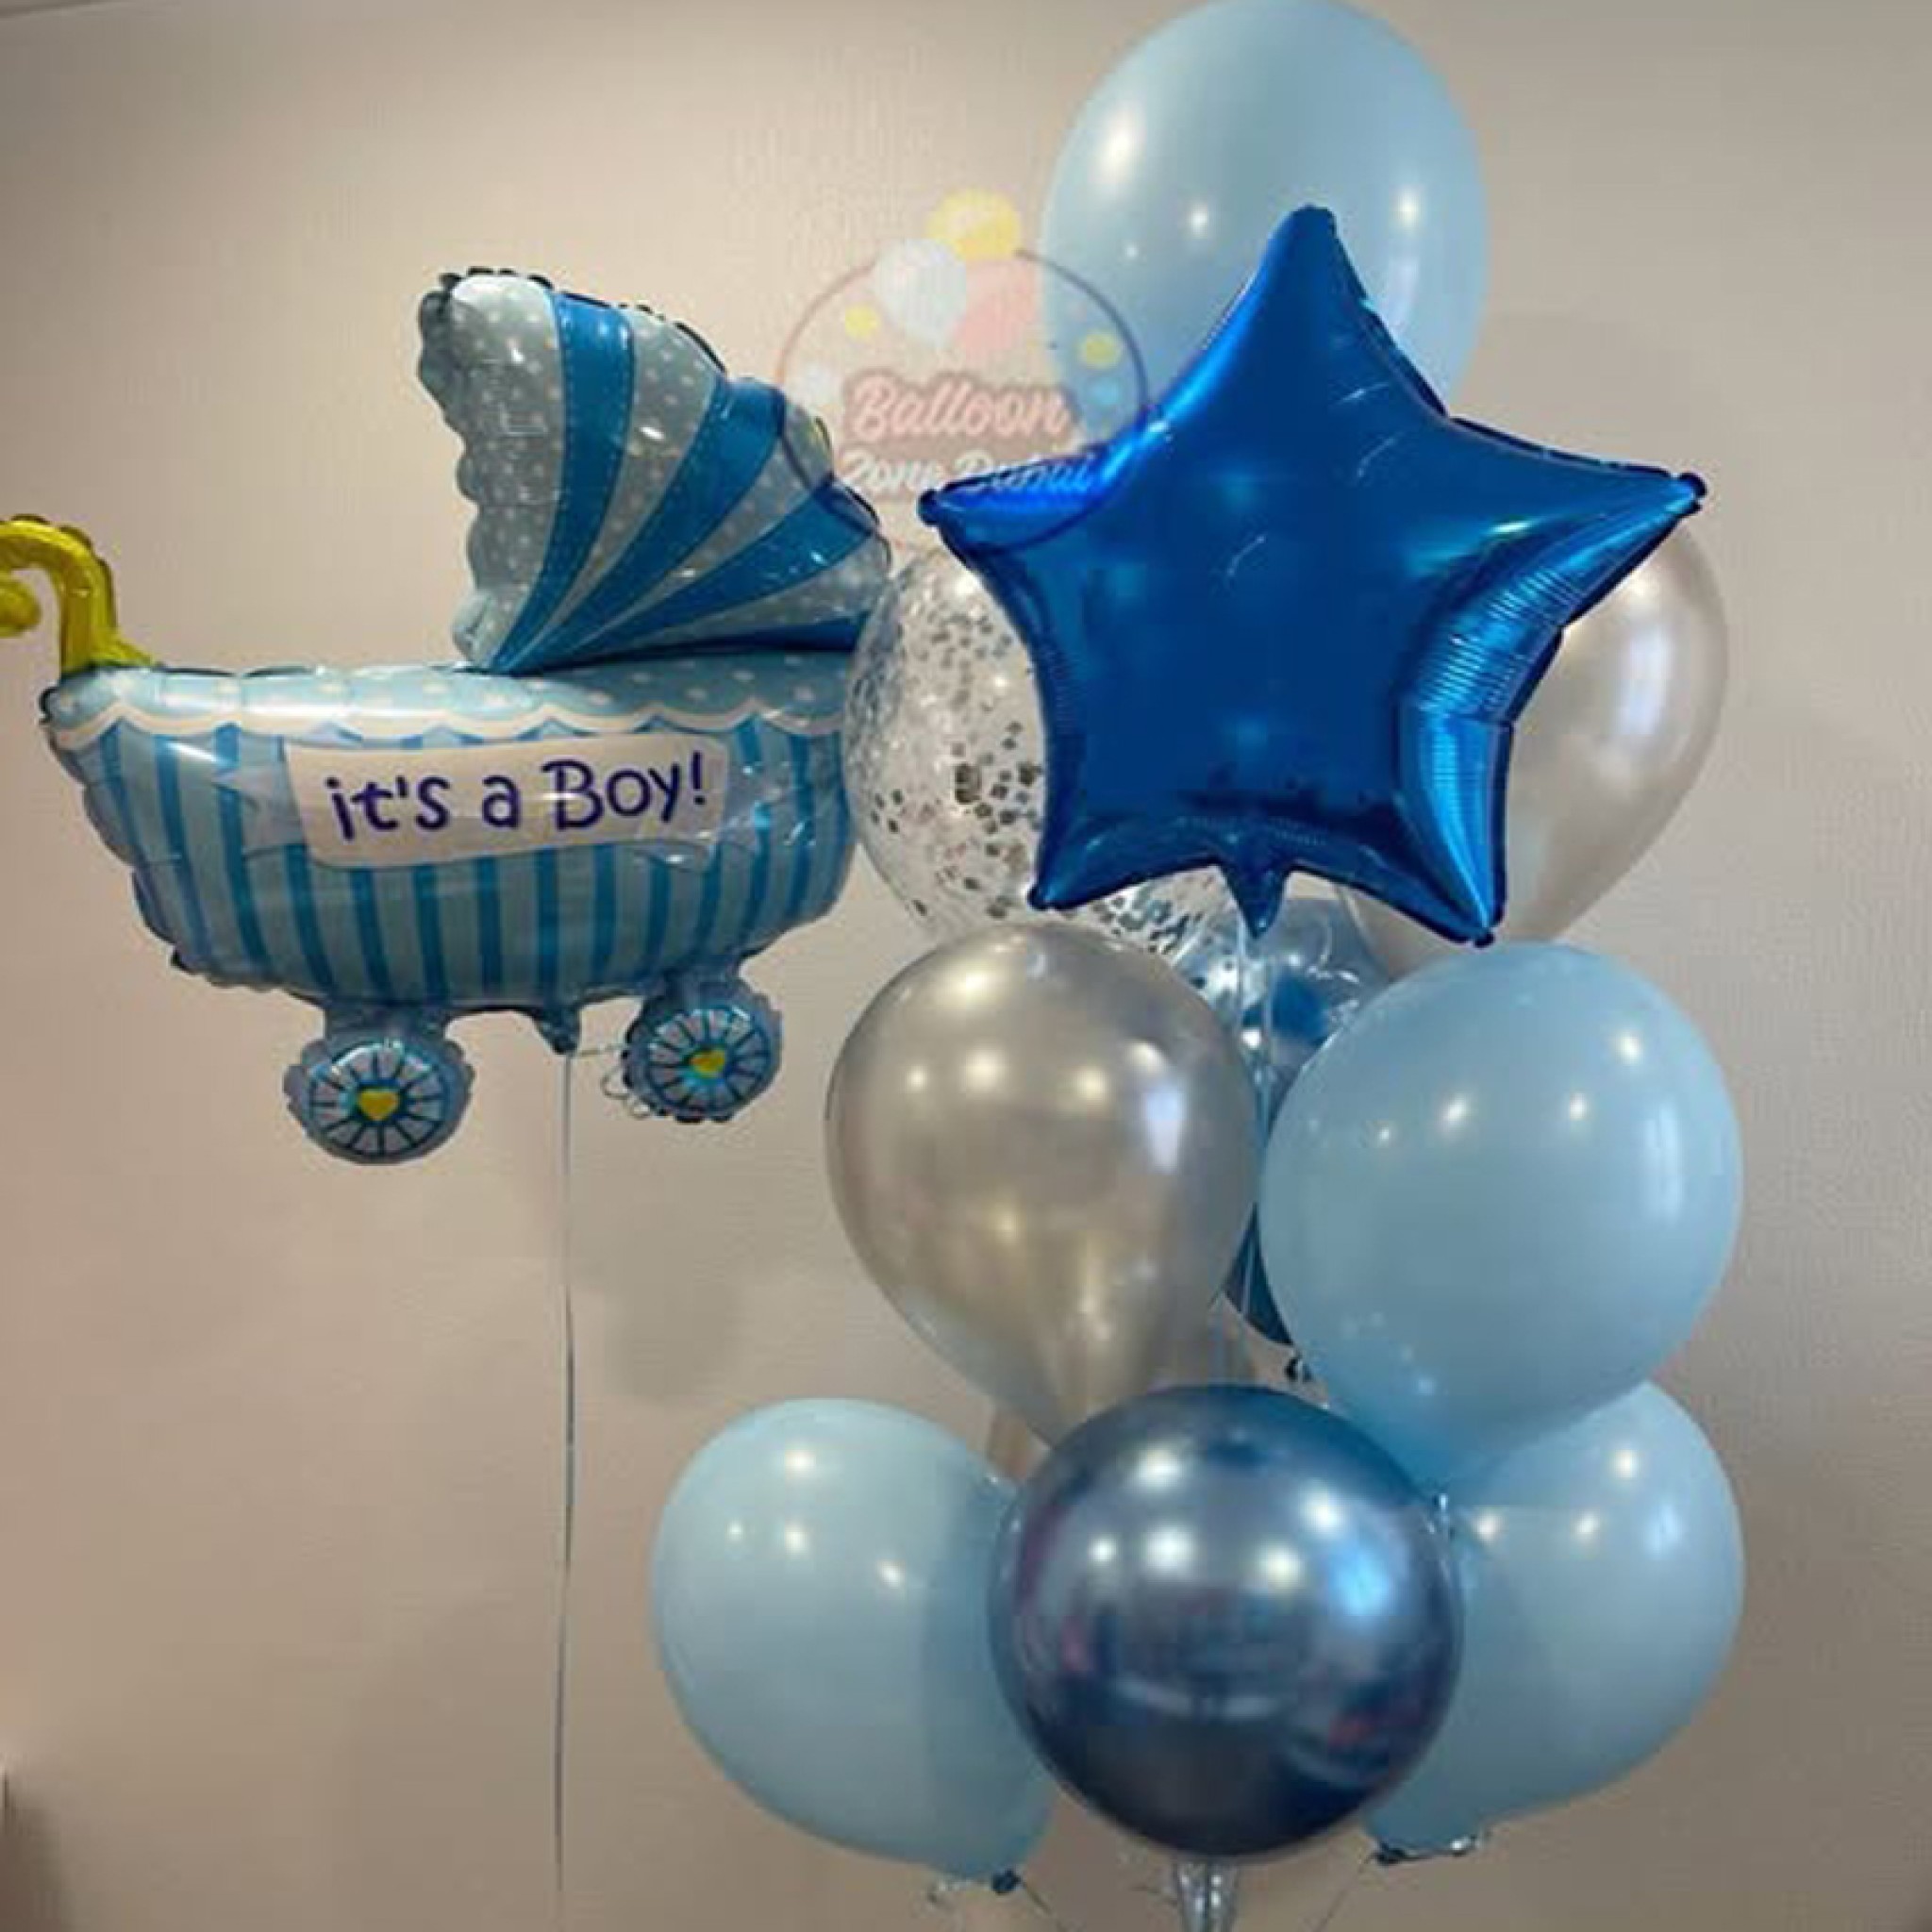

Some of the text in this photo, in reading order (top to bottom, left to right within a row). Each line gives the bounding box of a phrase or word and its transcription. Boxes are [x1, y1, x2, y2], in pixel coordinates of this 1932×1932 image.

[325, 750, 706, 841] it's a Boy!
